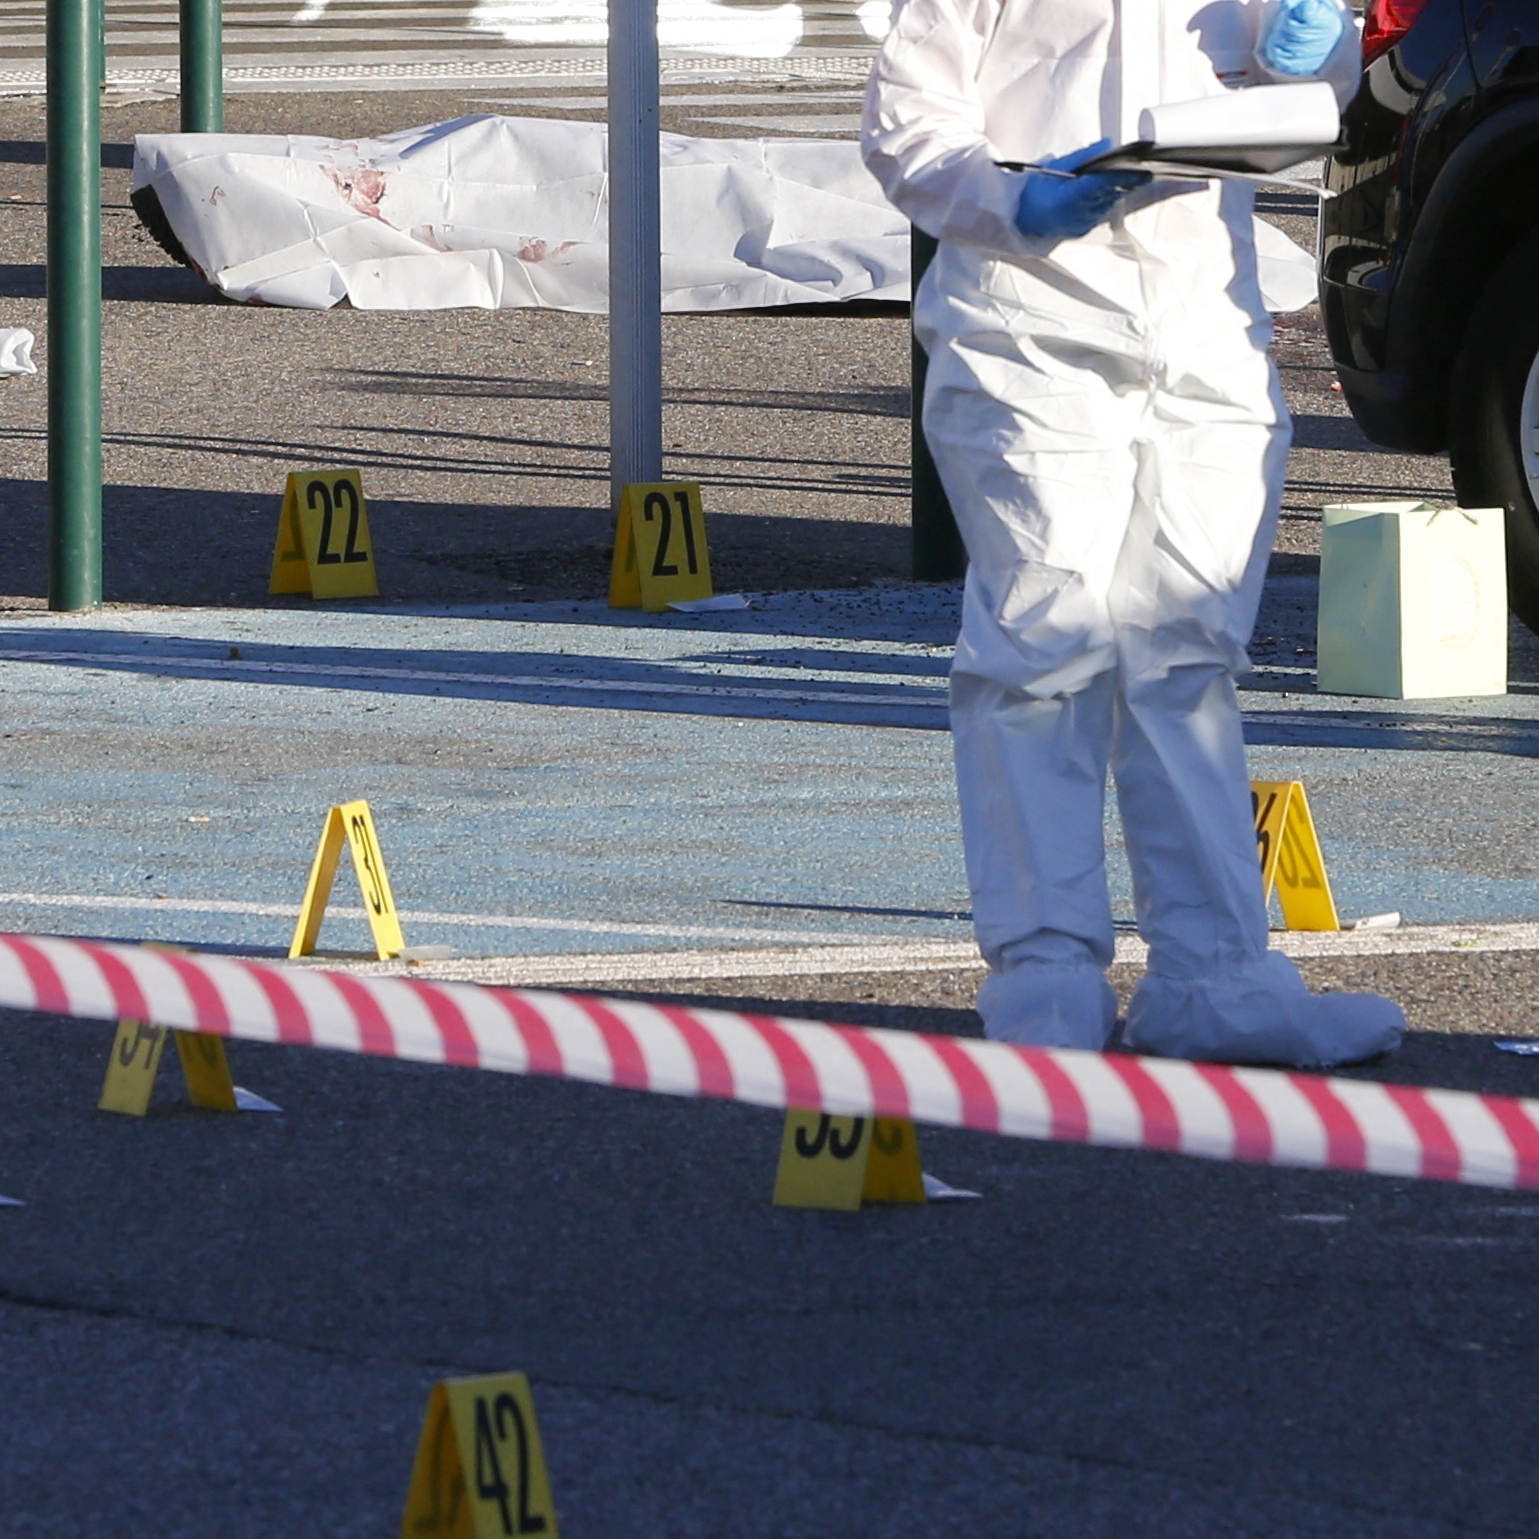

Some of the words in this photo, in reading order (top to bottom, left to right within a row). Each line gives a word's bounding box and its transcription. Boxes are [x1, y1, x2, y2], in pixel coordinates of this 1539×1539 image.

[307, 479, 369, 565] 22
[643, 491, 699, 578] 21
[475, 1393, 547, 1537] 42
